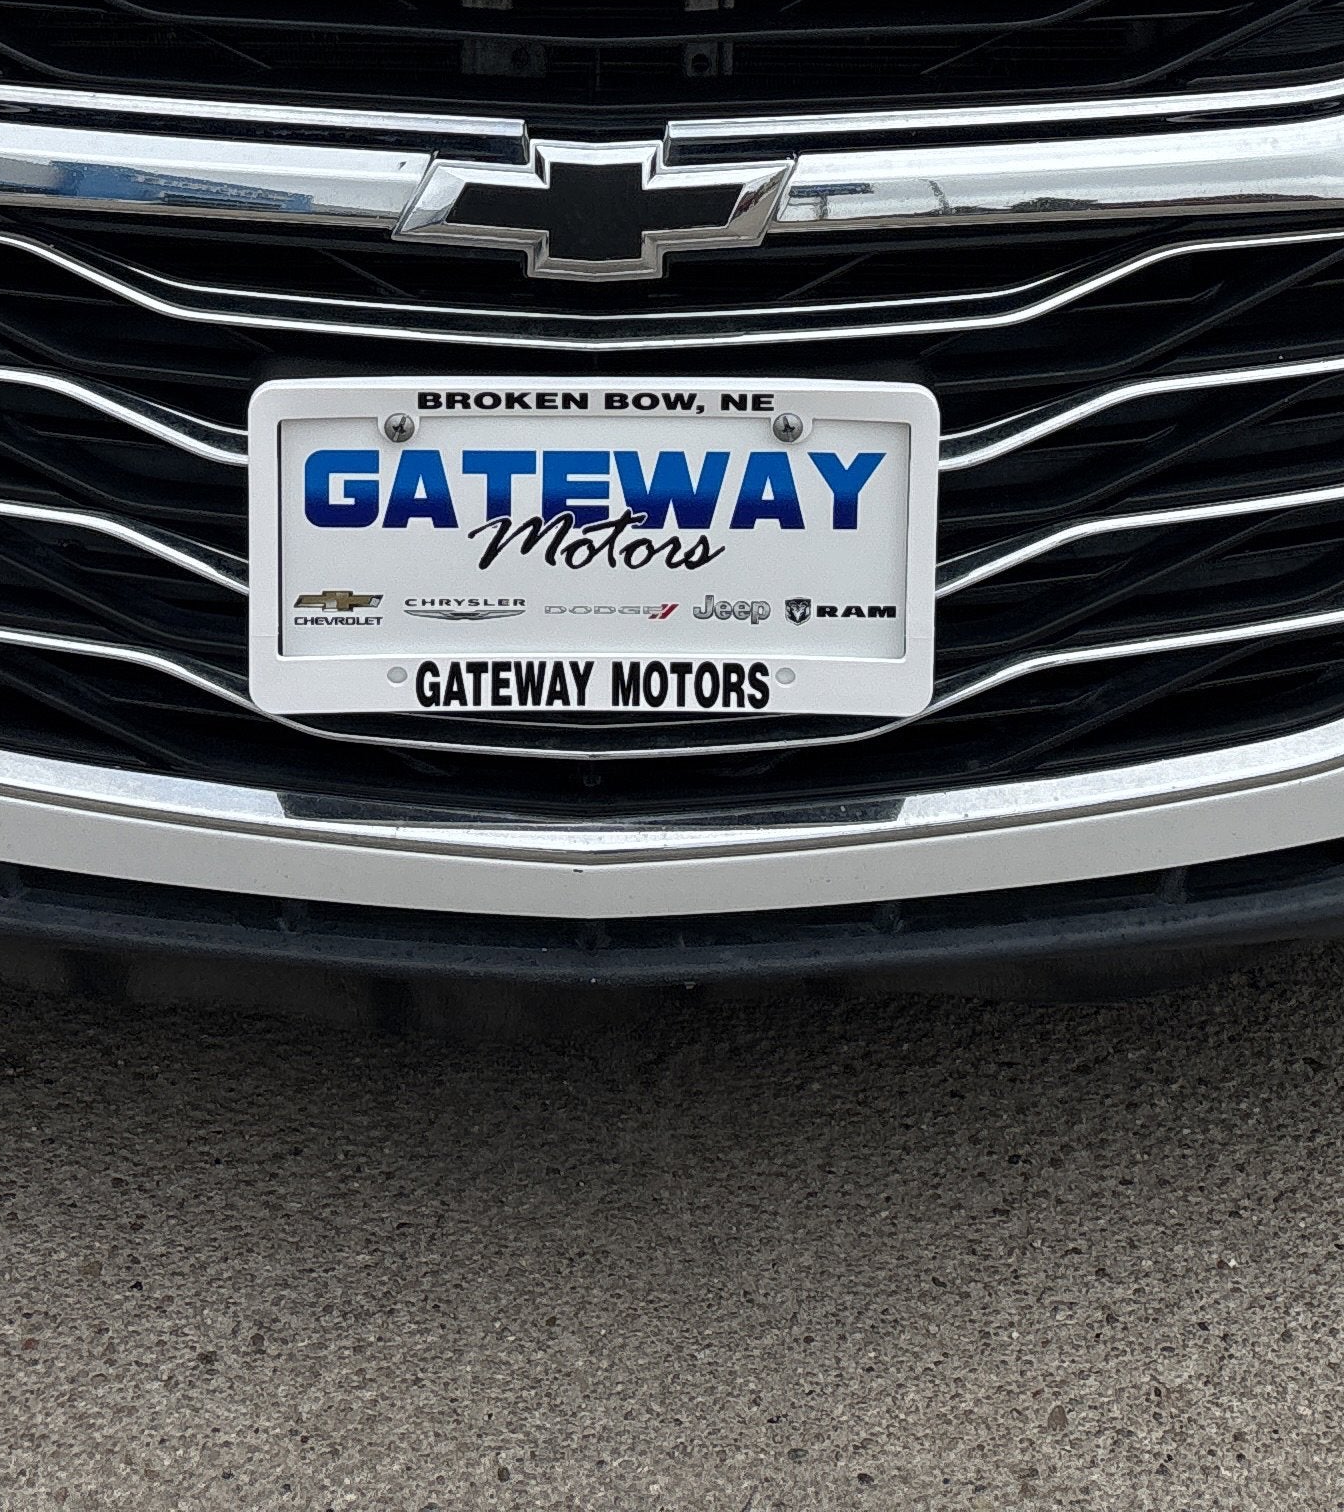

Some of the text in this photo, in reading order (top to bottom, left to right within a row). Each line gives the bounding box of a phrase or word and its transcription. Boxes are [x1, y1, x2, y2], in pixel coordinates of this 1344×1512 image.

[417, 391, 775, 415] BROKEN BOW, NE
[304, 449, 888, 530] GATEWAY
[467, 508, 726, 570] Motors
[404, 598, 527, 607] CHRYSLER
[544, 605, 662, 615] DODGE
[692, 594, 772, 625] Jeep
[816, 605, 897, 619] RAM
[293, 616, 384, 626] CHEVROLET
[415, 659, 771, 709] GATEWAY MOTORS
